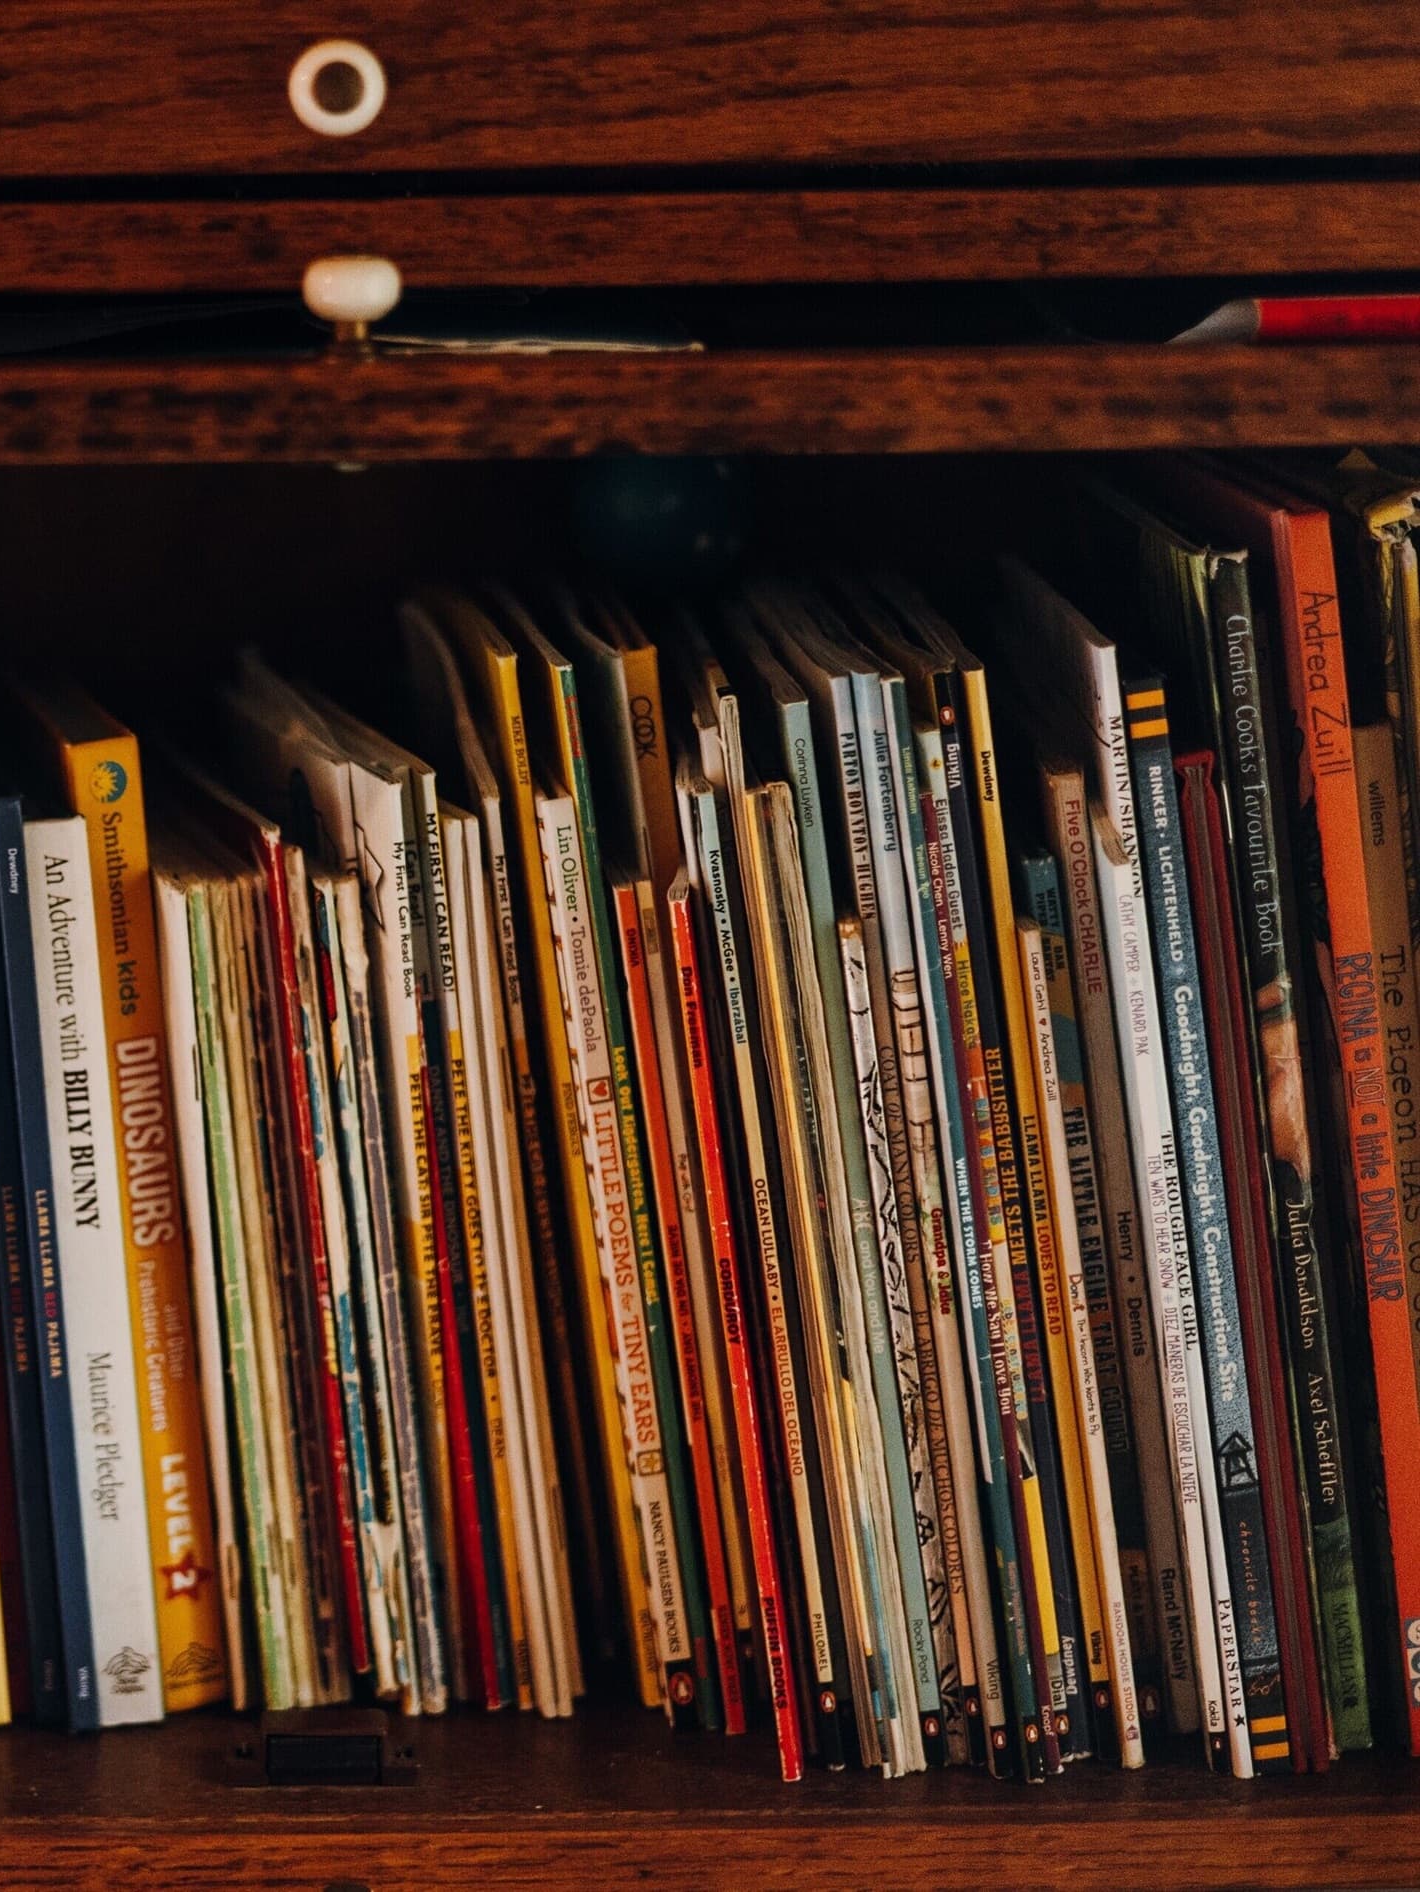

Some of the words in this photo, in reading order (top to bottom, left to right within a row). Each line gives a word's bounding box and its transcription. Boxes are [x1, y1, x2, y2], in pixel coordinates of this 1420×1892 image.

[1226, 615, 1251, 697] Charlie
[1301, 591, 1338, 691] Andrea
[794, 739, 809, 784] Corinna
[841, 732, 858, 785] PARTON
[1235, 705, 1261, 773] Cook's
[1312, 704, 1351, 777] Zuill
[800, 787, 815, 827] Luyken
[877, 766, 898, 852] Fortenberry
[1065, 800, 1081, 836] Five
[1243, 780, 1270, 892] Favourite
[1368, 780, 1387, 848] willems
[44, 855, 69, 884] An
[428, 843, 443, 886] FIRST
[557, 826, 572, 854] Lin
[560, 858, 579, 911] Oliver
[1068, 842, 1089, 907] O'Clock
[101, 812, 128, 955] Smithsonian
[116, 959, 138, 1016] kids
[434, 903, 448, 938] CAN
[1253, 901, 1281, 955] Book
[48, 894, 76, 1005] Adventure
[439, 944, 454, 993] READ!
[570, 927, 588, 981] Tomie
[710, 850, 727, 913] Kvasnosky
[721, 929, 735, 972] McGee
[730, 988, 746, 1044] Ibarzábal
[1079, 914, 1103, 994] CHARLIE
[1381, 946, 1408, 1008] The
[980, 750, 995, 802] Dewdney
[1023, 1115, 1037, 1167] LLAMA
[1030, 1171, 1045, 1222] LLAMA
[1335, 953, 1378, 1042] REGINA
[59, 1013, 88, 1061] with
[579, 986, 600, 1053] dePaola
[879, 1047, 897, 1096] COAT
[1149, 766, 1167, 828] RINKER
[1159, 846, 1183, 961] LICHTENHELD
[1174, 986, 1201, 1101] Goodnight,
[1203, 1227, 1230, 1359] Construction
[1352, 1068, 1385, 1105] NOT
[1386, 1026, 1417, 1144] Pigeon
[63, 1069, 93, 1137] BILLY
[984, 1049, 1015, 1162] BABYSITTER
[115, 1037, 175, 1248] DINOSAURS
[594, 1111, 622, 1197] LITTLE
[889, 1130, 910, 1188] MANY
[1356, 1132, 1390, 1180] little
[69, 1144, 100, 1230] BUNNY
[755, 1179, 769, 1226] OCEAN
[607, 1200, 635, 1287] POEMS
[899, 1191, 920, 1264] COLORS
[1005, 1205, 1029, 1265] MEETS
[1117, 1211, 1134, 1262] Henry
[1286, 1199, 1311, 1248] Julia
[1361, 1188, 1404, 1301] DINOSAUR
[761, 1229, 778, 1289] LULLABY
[1127, 1297, 1146, 1357] Dennis
[1182, 1305, 1199, 1351] GIRL
[1294, 1254, 1319, 1349] Donaldson
[622, 1315, 648, 1374] TINY
[774, 1326, 793, 1387] ARRULLO
[87, 1352, 116, 1433] Maurice
[631, 1384, 656, 1444] EARS
[1307, 1372, 1328, 1414] Axel
[93, 1442, 125, 1521] Pledger
[1314, 1420, 1339, 1505] Scheffler
[160, 1453, 193, 1554] LEVEL
[655, 1550, 674, 1607] PAULSEN
[1161, 1568, 1180, 1611] Rand
[813, 1613, 828, 1671] PHILOMEL
[1167, 1615, 1187, 1681] McNally
